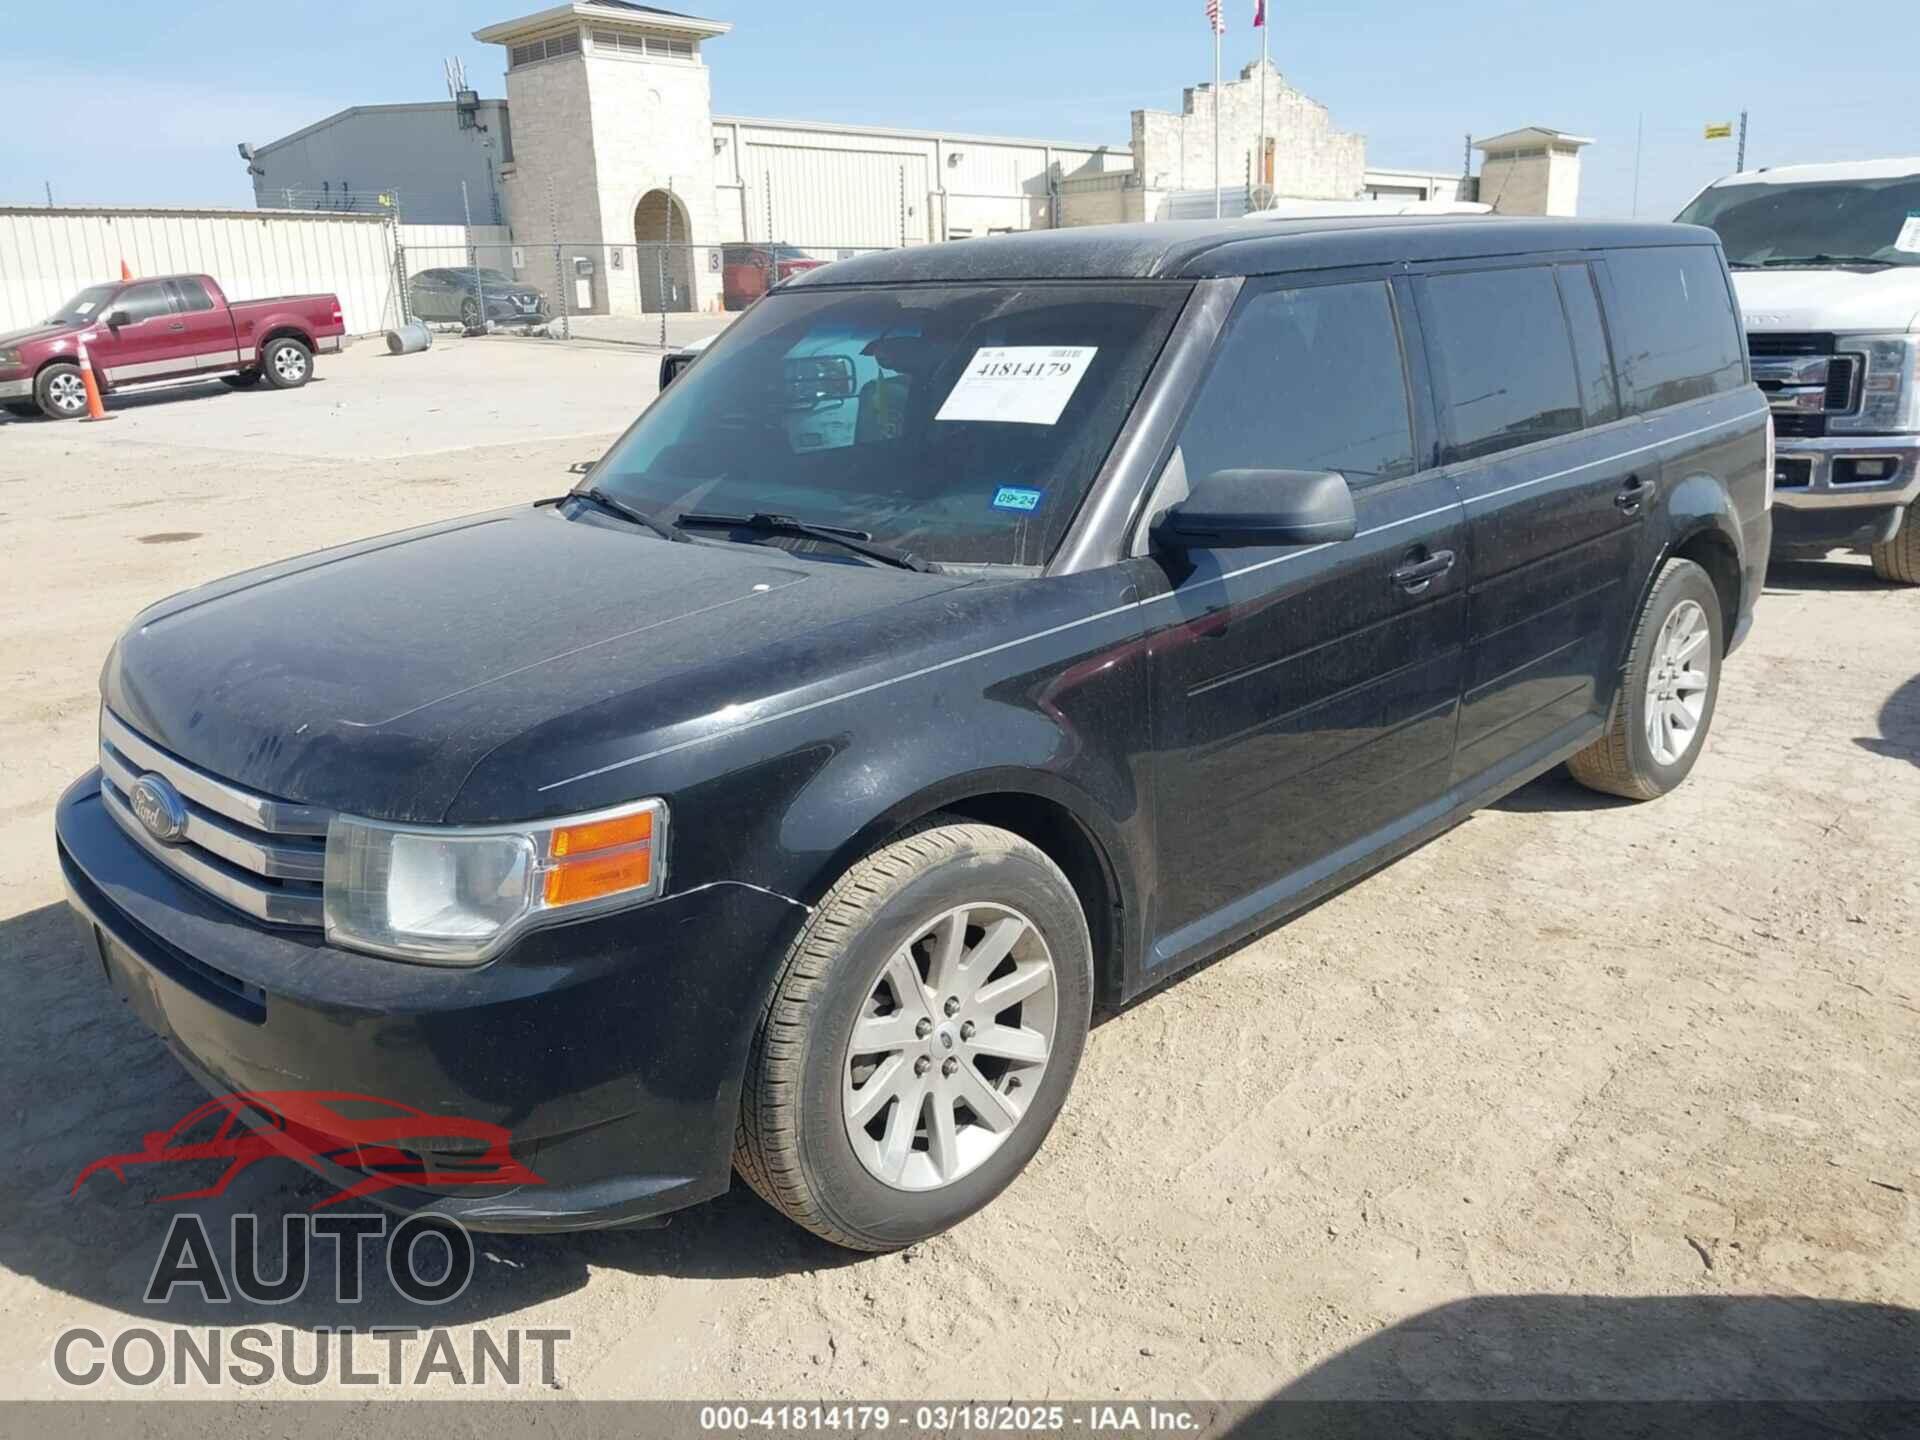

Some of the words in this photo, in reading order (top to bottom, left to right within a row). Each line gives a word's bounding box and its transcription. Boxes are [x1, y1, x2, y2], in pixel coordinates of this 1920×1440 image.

[613, 251, 621, 267] 2
[711, 253, 720, 269] 3
[976, 362, 1072, 377] 41814179
